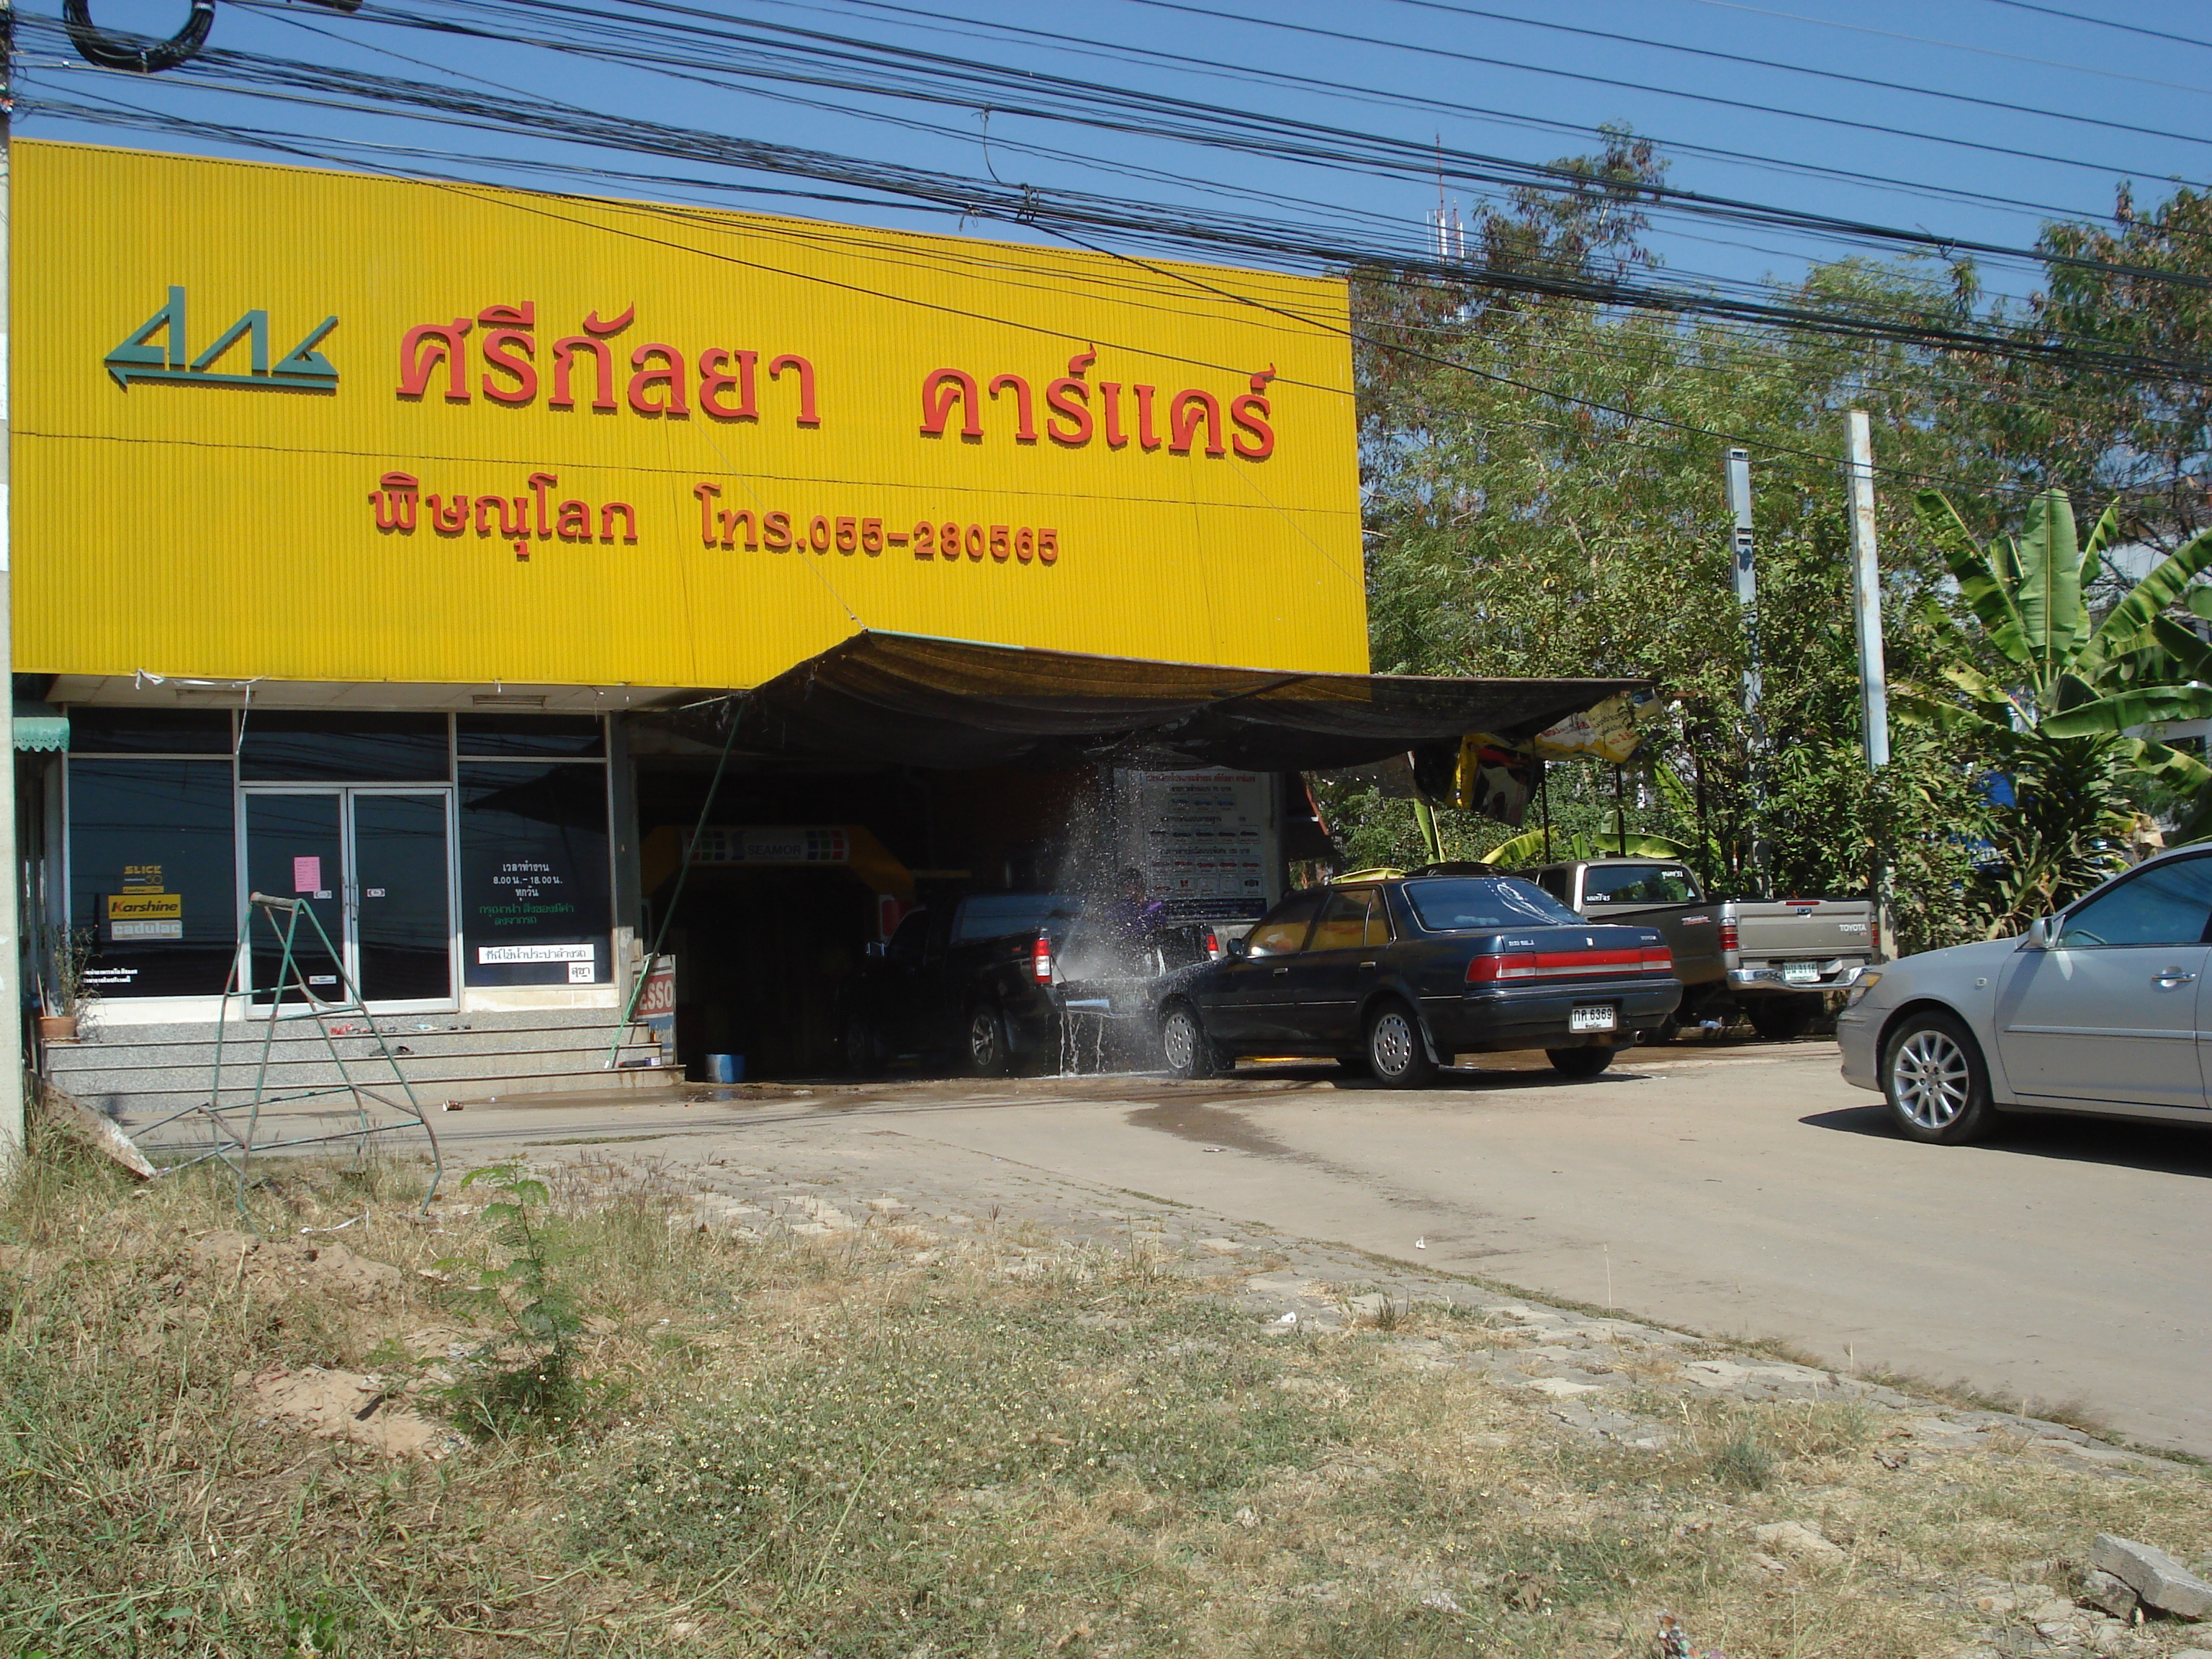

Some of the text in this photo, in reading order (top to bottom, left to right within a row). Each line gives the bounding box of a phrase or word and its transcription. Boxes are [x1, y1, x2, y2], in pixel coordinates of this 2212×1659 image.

[396, 301, 822, 424] ศรีกัลยา
[920, 343, 1277, 458] คาร์แคร์
[369, 472, 1059, 562] พิษณุโลก โทร.055-280565
[747, 845, 801, 855] SEAMOR
[124, 866, 162, 874] SLICK
[503, 860, 549, 872] เวลาทำงาน
[516, 886, 539, 902] ทุกวัน
[111, 900, 179, 913] Karshine
[571, 966, 590, 978] สุขา
[1590, 1008, 1613, 1020] 6369
